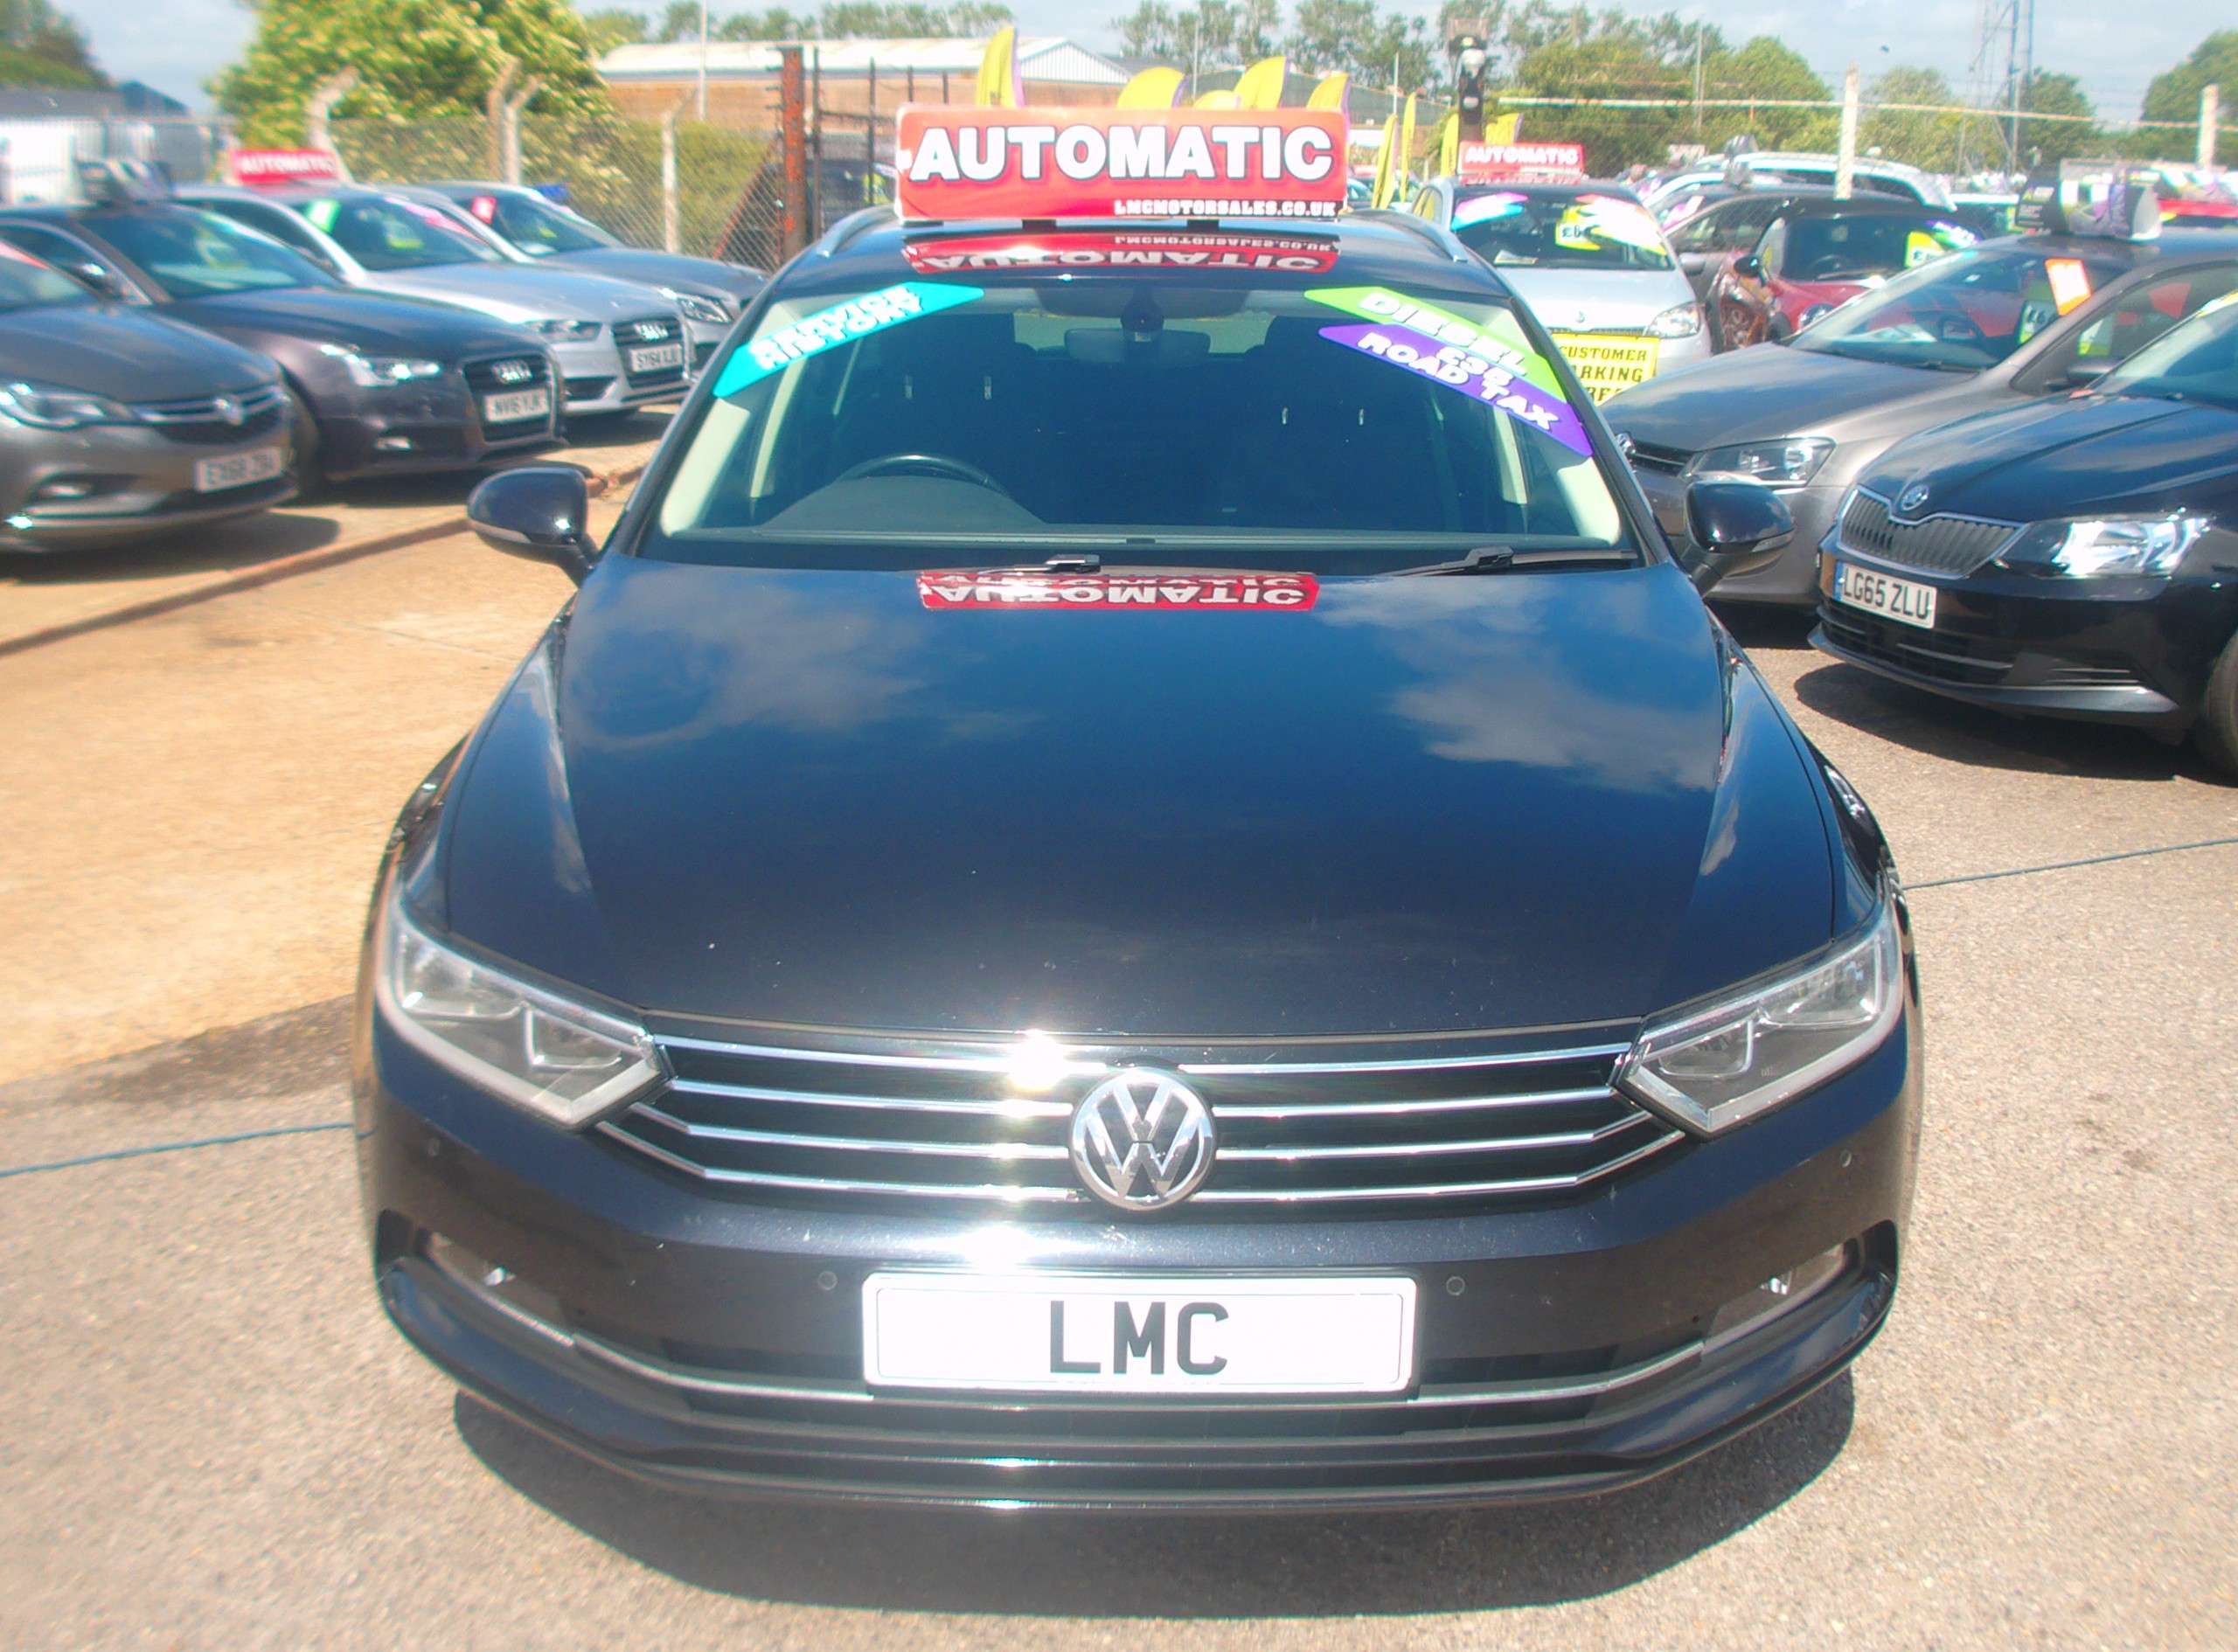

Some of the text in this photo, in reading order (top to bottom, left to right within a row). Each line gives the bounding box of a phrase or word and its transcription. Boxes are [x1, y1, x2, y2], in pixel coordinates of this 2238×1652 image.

[909, 125, 1334, 182] AUTOMATIC
[1465, 146, 1579, 165] AUTOMATIC
[1114, 199, 1337, 218] LMCMOTORSALES.CO.UK
[1358, 292, 1528, 376] DIESEL
[1357, 331, 1560, 431] ROAD TAX
[1844, 567, 1930, 620] LG65 ZLU
[1050, 1300, 1230, 1376] LMC
